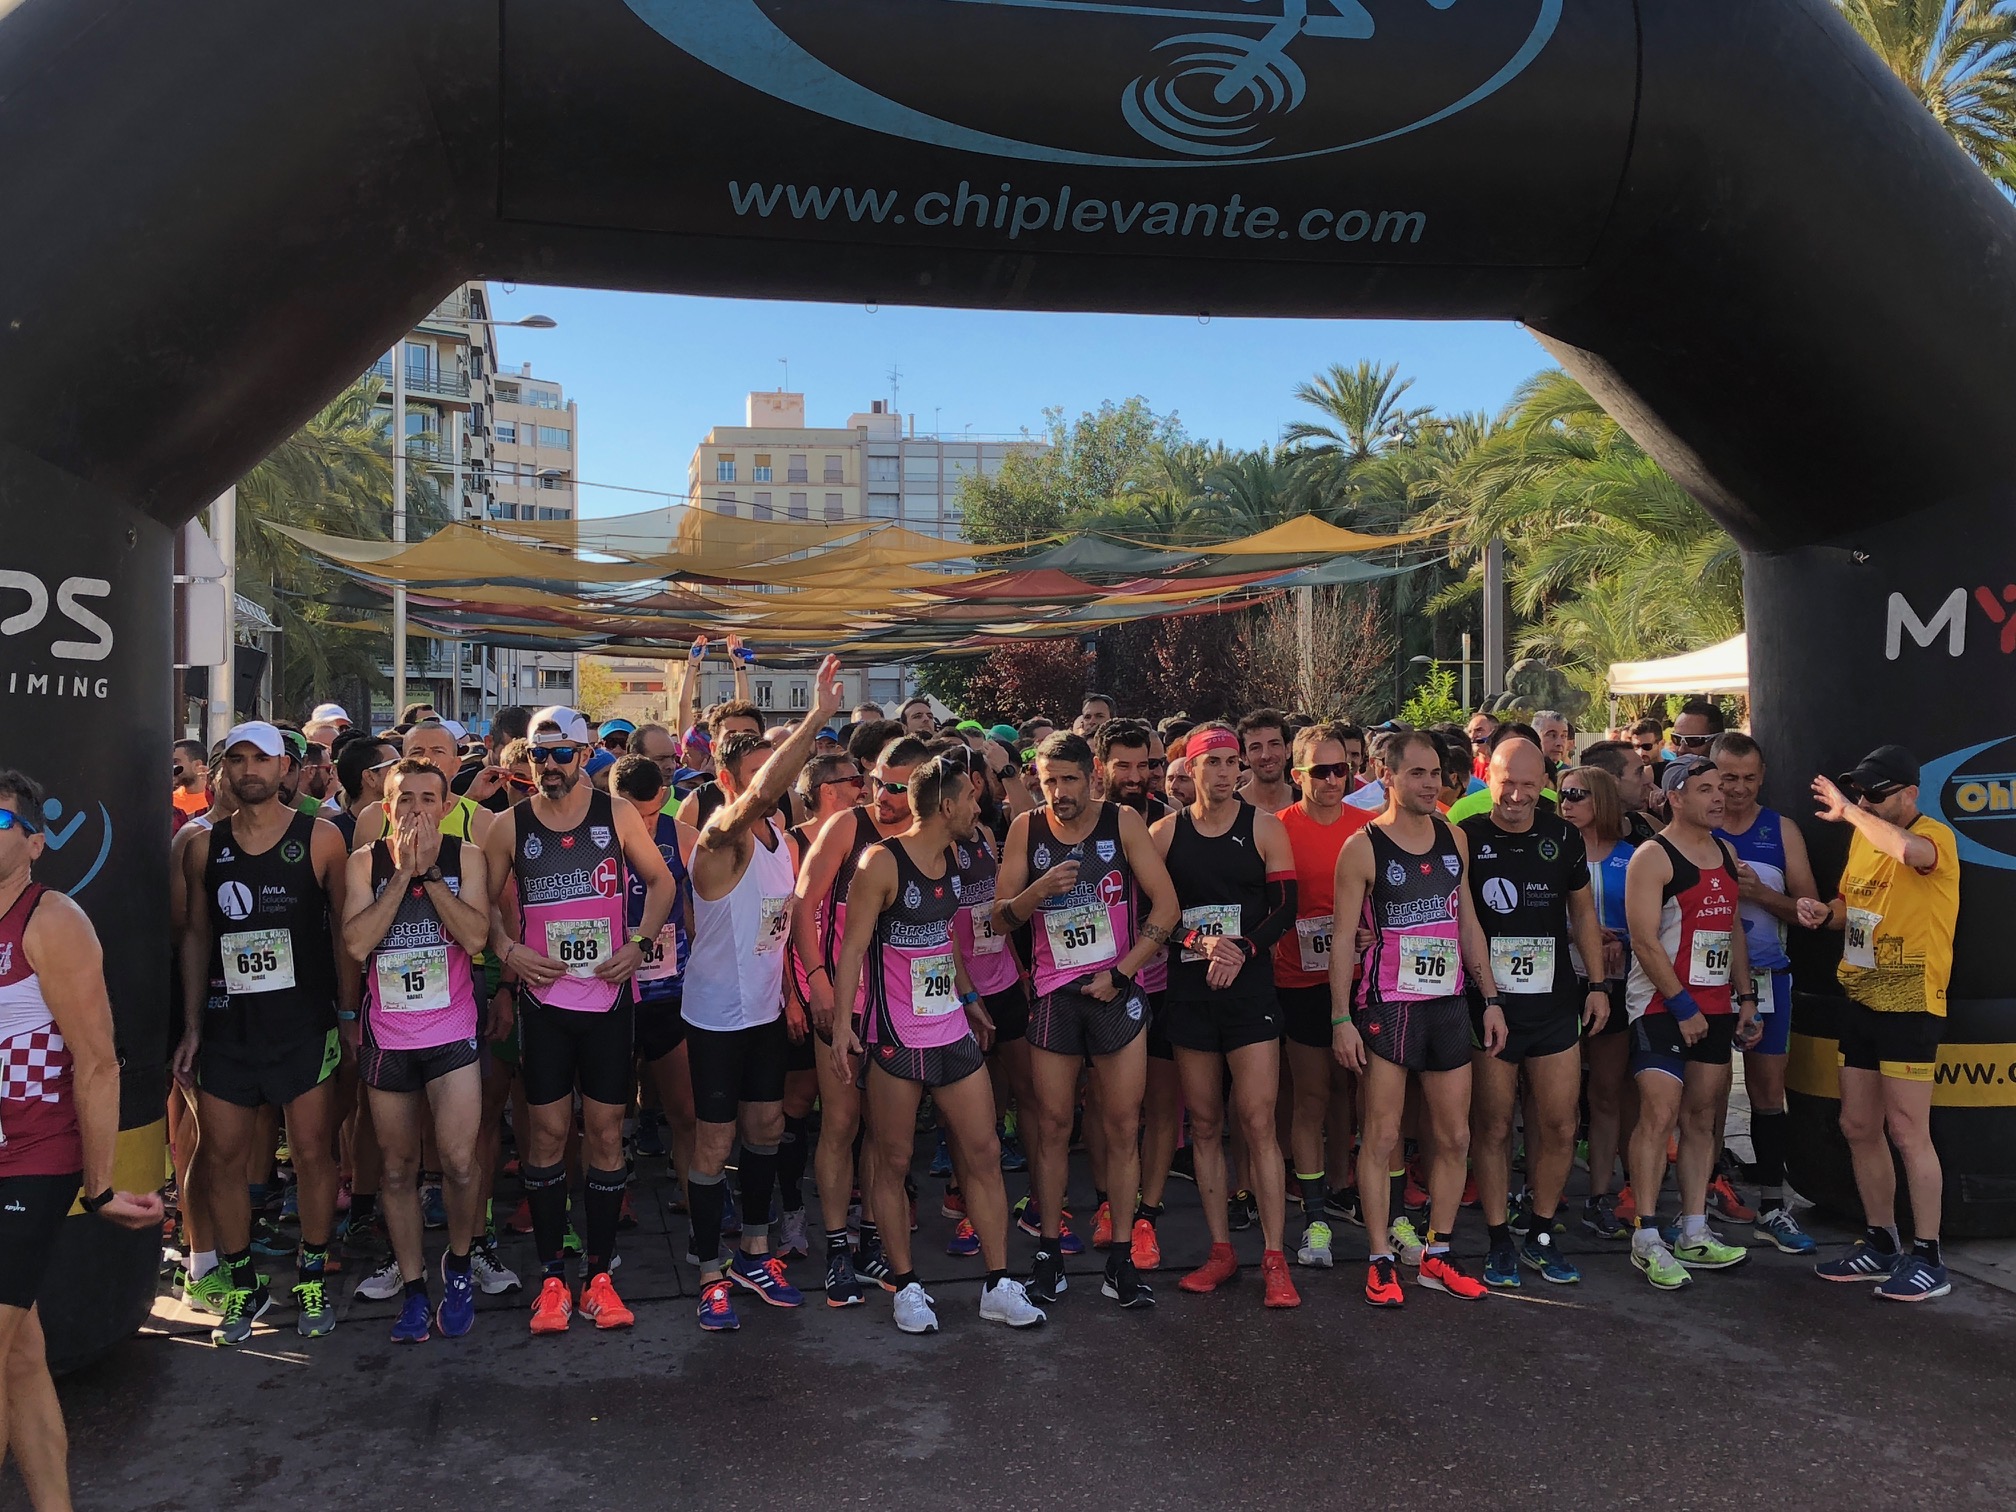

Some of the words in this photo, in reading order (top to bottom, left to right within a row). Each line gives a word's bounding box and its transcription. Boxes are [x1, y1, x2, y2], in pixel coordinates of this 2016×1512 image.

[728, 180, 1428, 244] www.chiplevante.com
[262, 885, 286, 895] ÁVILA
[960, 876, 996, 895] erreteria
[1386, 894, 1447, 916] ferreteria
[1703, 894, 1730, 906] C.A.
[1388, 911, 1422, 925] antonio
[1696, 906, 1732, 919] ASPIS
[385, 919, 438, 937] reteria
[890, 918, 948, 937] ferreteria
[1062, 924, 1097, 949] 357
[1849, 926, 1865, 949] 394
[890, 934, 926, 945] antonio
[560, 939, 598, 961] 683
[1705, 949, 1729, 969] 614
[236, 951, 278, 975] 635
[1414, 955, 1446, 977] 576
[1510, 956, 1534, 976] 25
[401, 970, 425, 993] 15
[924, 974, 951, 997] 299
